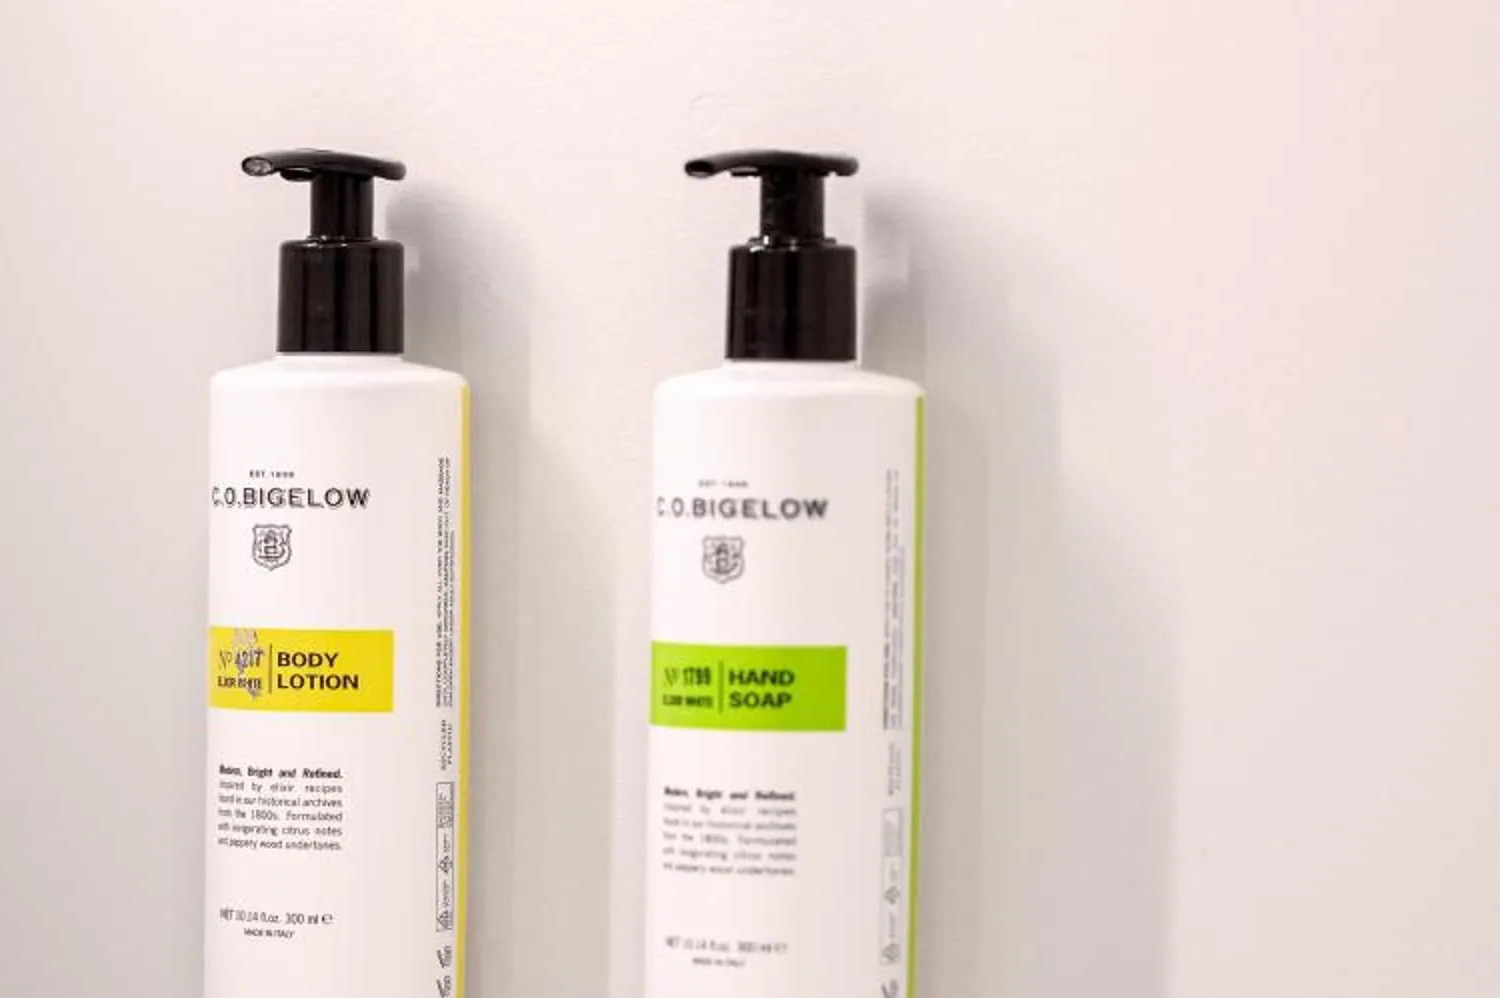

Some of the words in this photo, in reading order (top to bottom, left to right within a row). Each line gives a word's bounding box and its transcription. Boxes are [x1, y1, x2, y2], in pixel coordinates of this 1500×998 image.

[277, 651, 339, 668] BODY
[277, 673, 360, 690] LOTION
[728, 668, 795, 687] HAND
[728, 690, 793, 709] SOAP
[285, 911, 305, 925] 300
